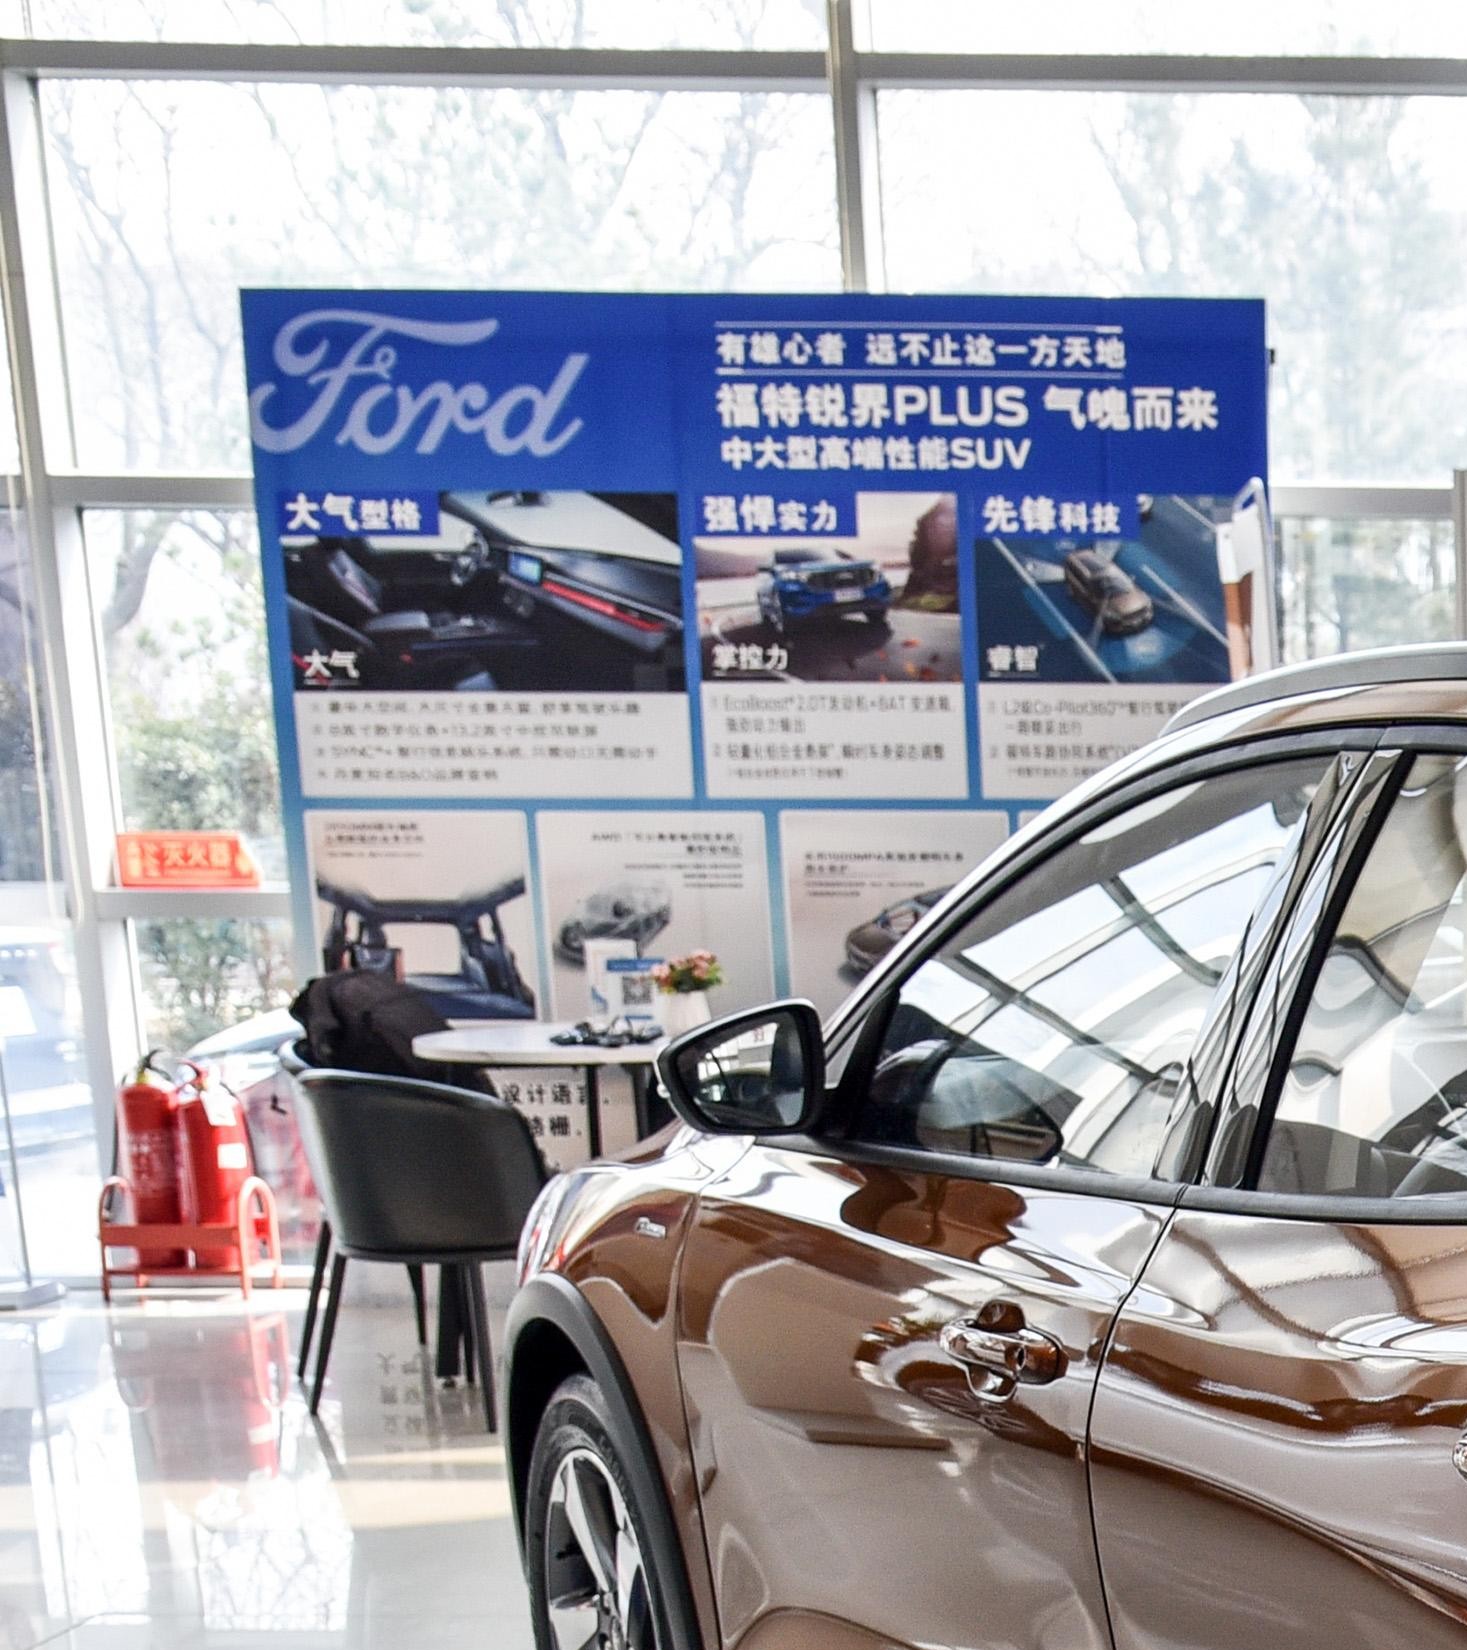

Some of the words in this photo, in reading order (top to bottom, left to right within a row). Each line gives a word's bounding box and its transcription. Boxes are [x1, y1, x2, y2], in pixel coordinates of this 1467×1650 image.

[249, 308, 590, 457] Ford
[716, 383, 1029, 429] 福特锐界PLUS
[285, 492, 421, 531] 大气型格
[703, 496, 837, 533] 强悍实力
[983, 496, 1120, 534] 先锋科技
[304, 650, 360, 678] 大气
